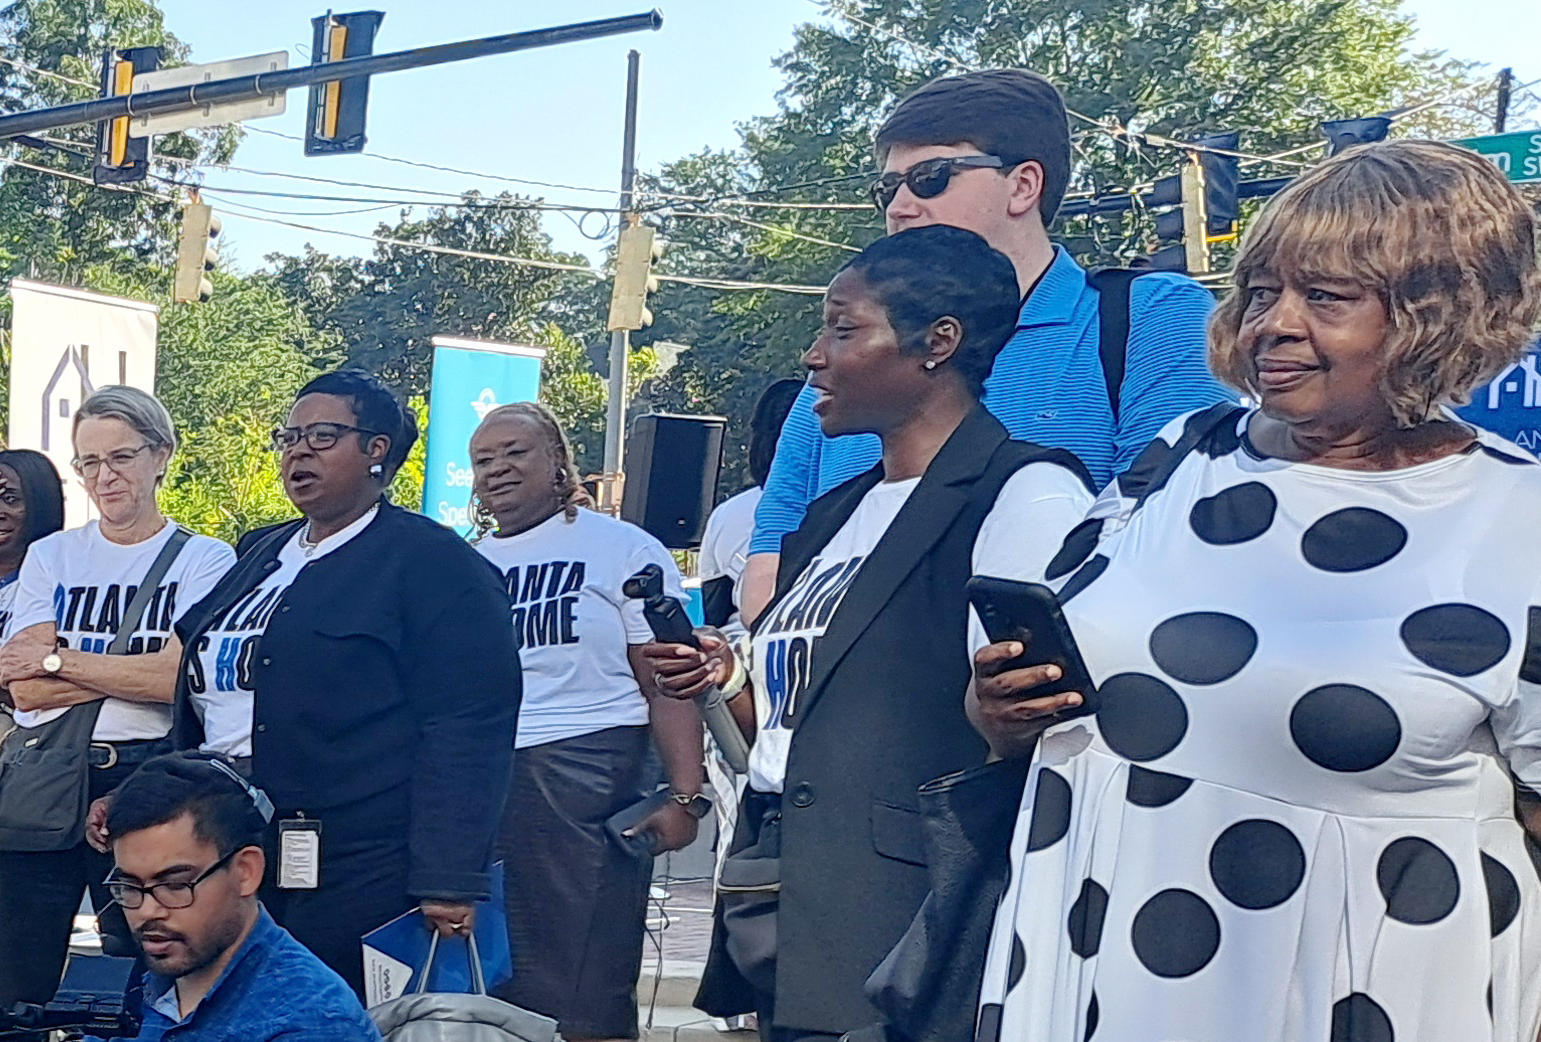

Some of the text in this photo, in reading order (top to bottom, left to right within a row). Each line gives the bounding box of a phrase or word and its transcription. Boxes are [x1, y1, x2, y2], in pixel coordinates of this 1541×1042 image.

[438, 501, 469, 527] Spe
[506, 560, 586, 605] ANTA
[511, 597, 581, 649] OME
